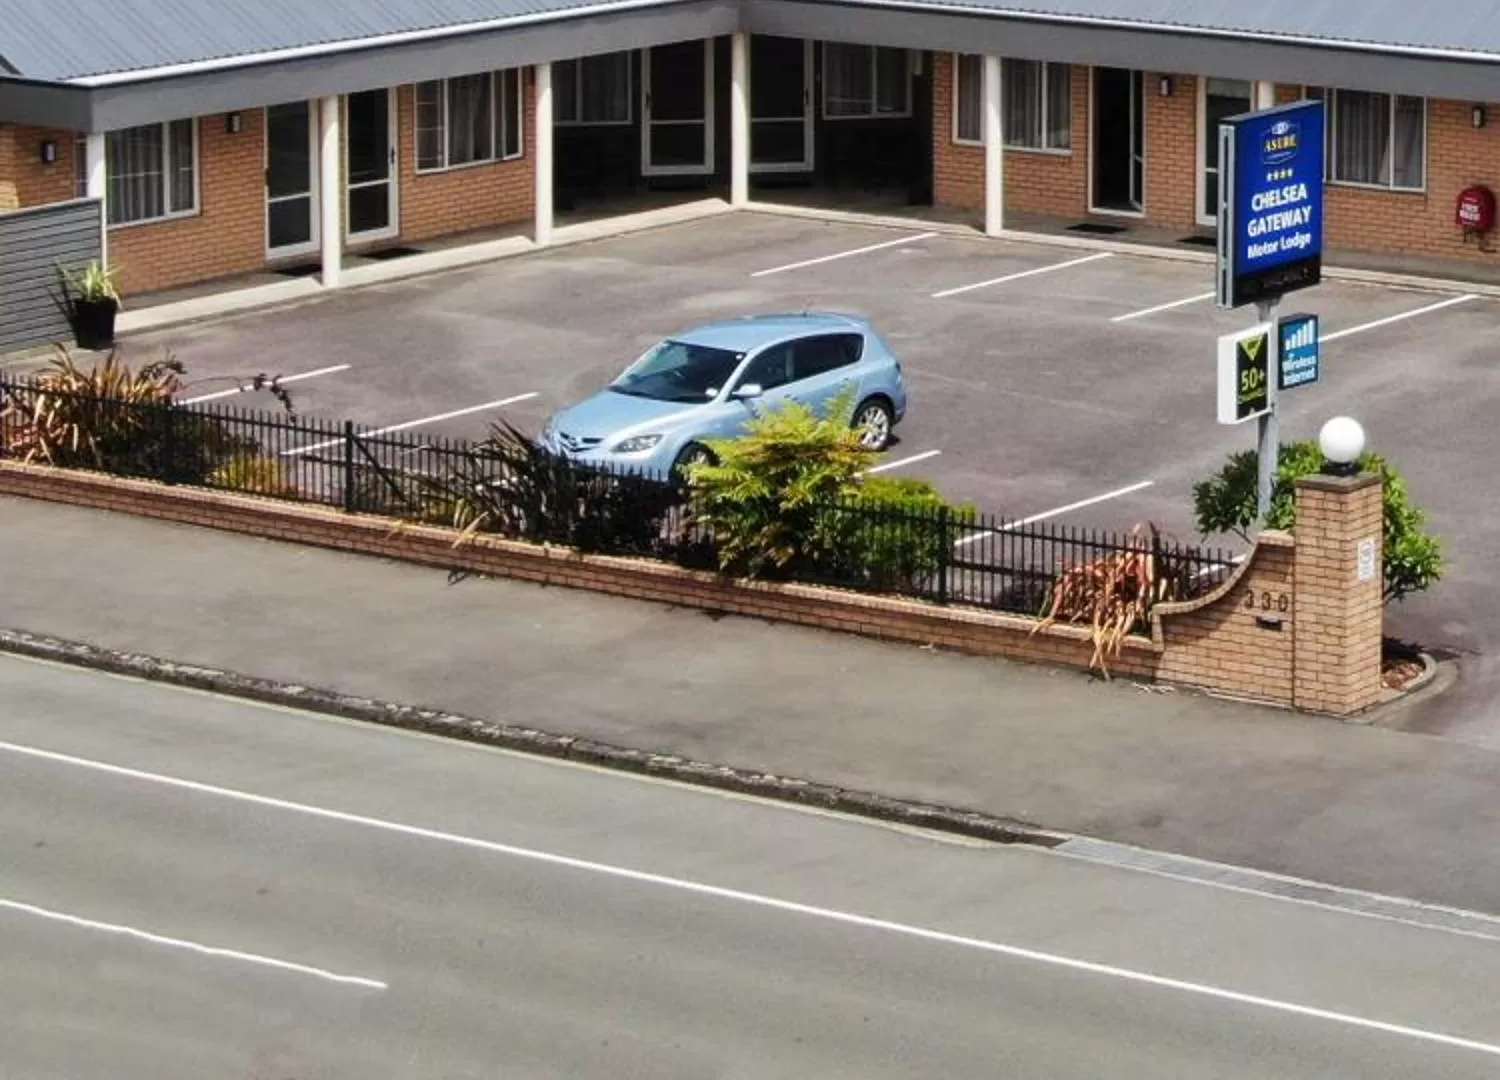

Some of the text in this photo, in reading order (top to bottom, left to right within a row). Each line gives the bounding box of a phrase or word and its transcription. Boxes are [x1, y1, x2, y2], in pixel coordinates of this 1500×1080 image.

[1251, 183, 1307, 211] CHELSEA
[1247, 205, 1312, 237] GATEWAY
[1247, 232, 1311, 259] Motor Lodge
[1244, 589, 1289, 612] 330
